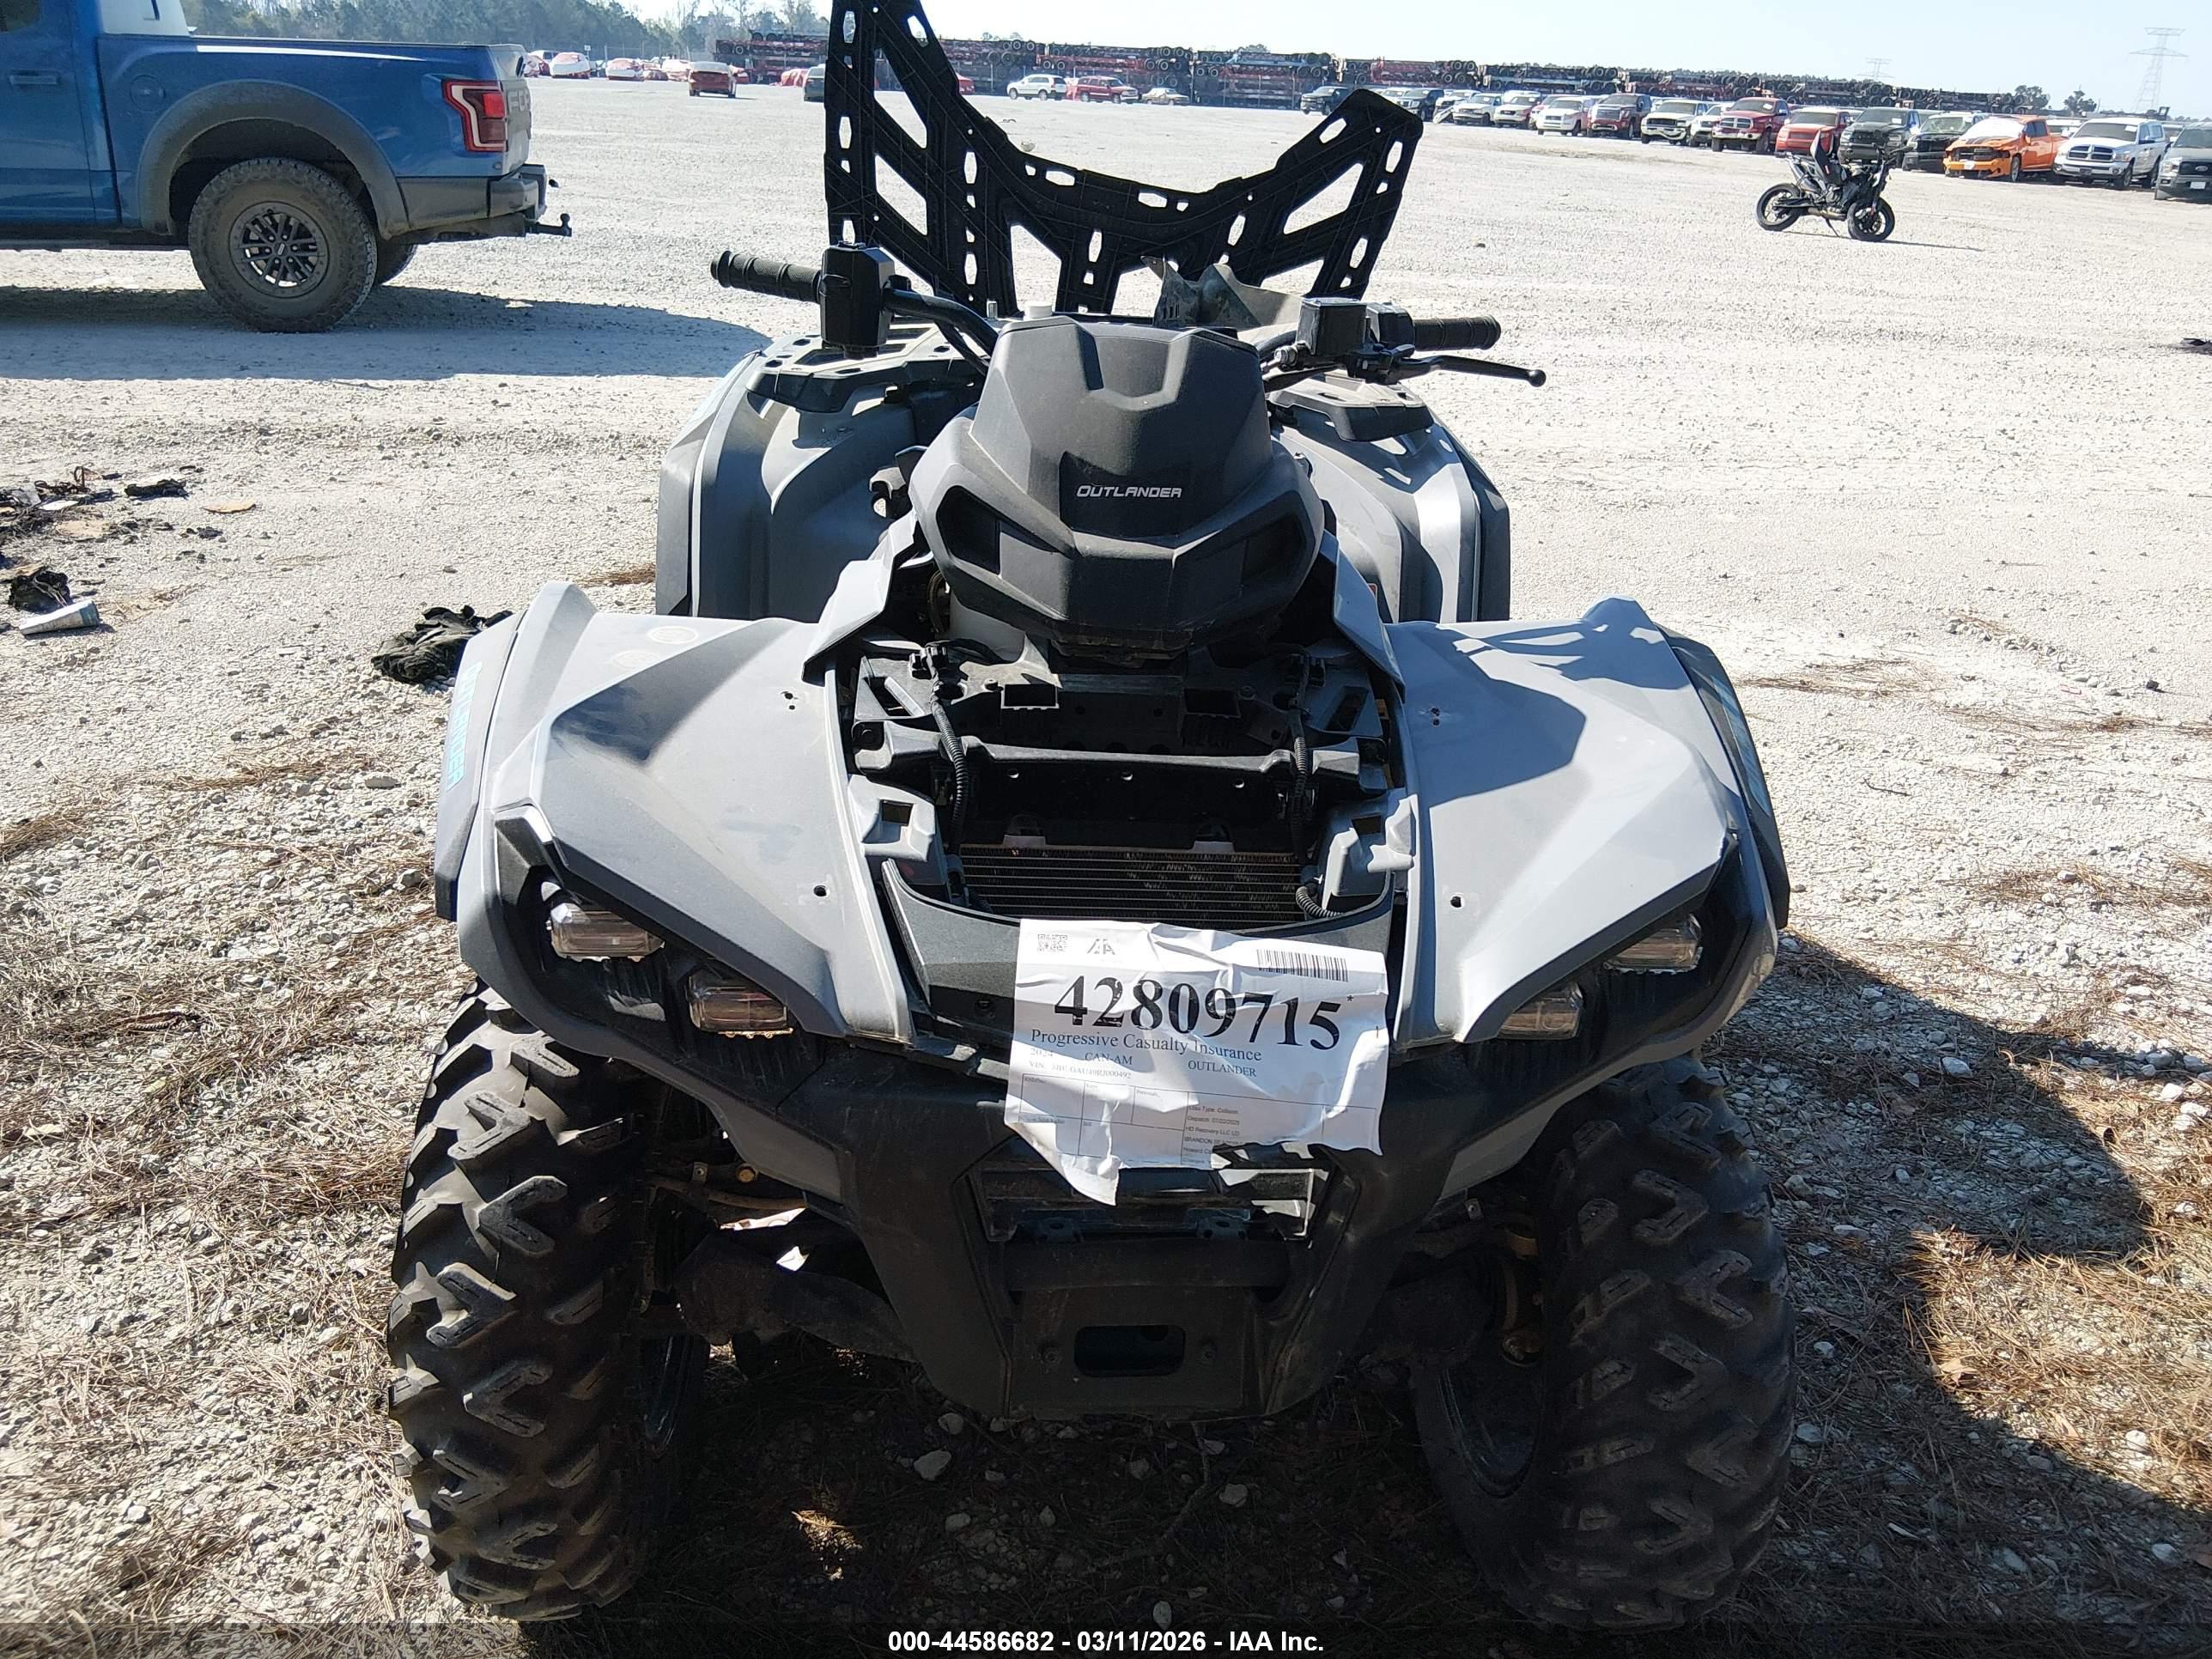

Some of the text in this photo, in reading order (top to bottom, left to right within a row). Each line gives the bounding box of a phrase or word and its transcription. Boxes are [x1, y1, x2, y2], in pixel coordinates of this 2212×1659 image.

[1076, 485, 1182, 498] OUTLANDER
[1031, 1030, 1262, 1061] Progressive Casualty Insurance
[1085, 1052, 1133, 1066] CAN-AM
[1188, 1060, 1257, 1078] OUTLANDER
